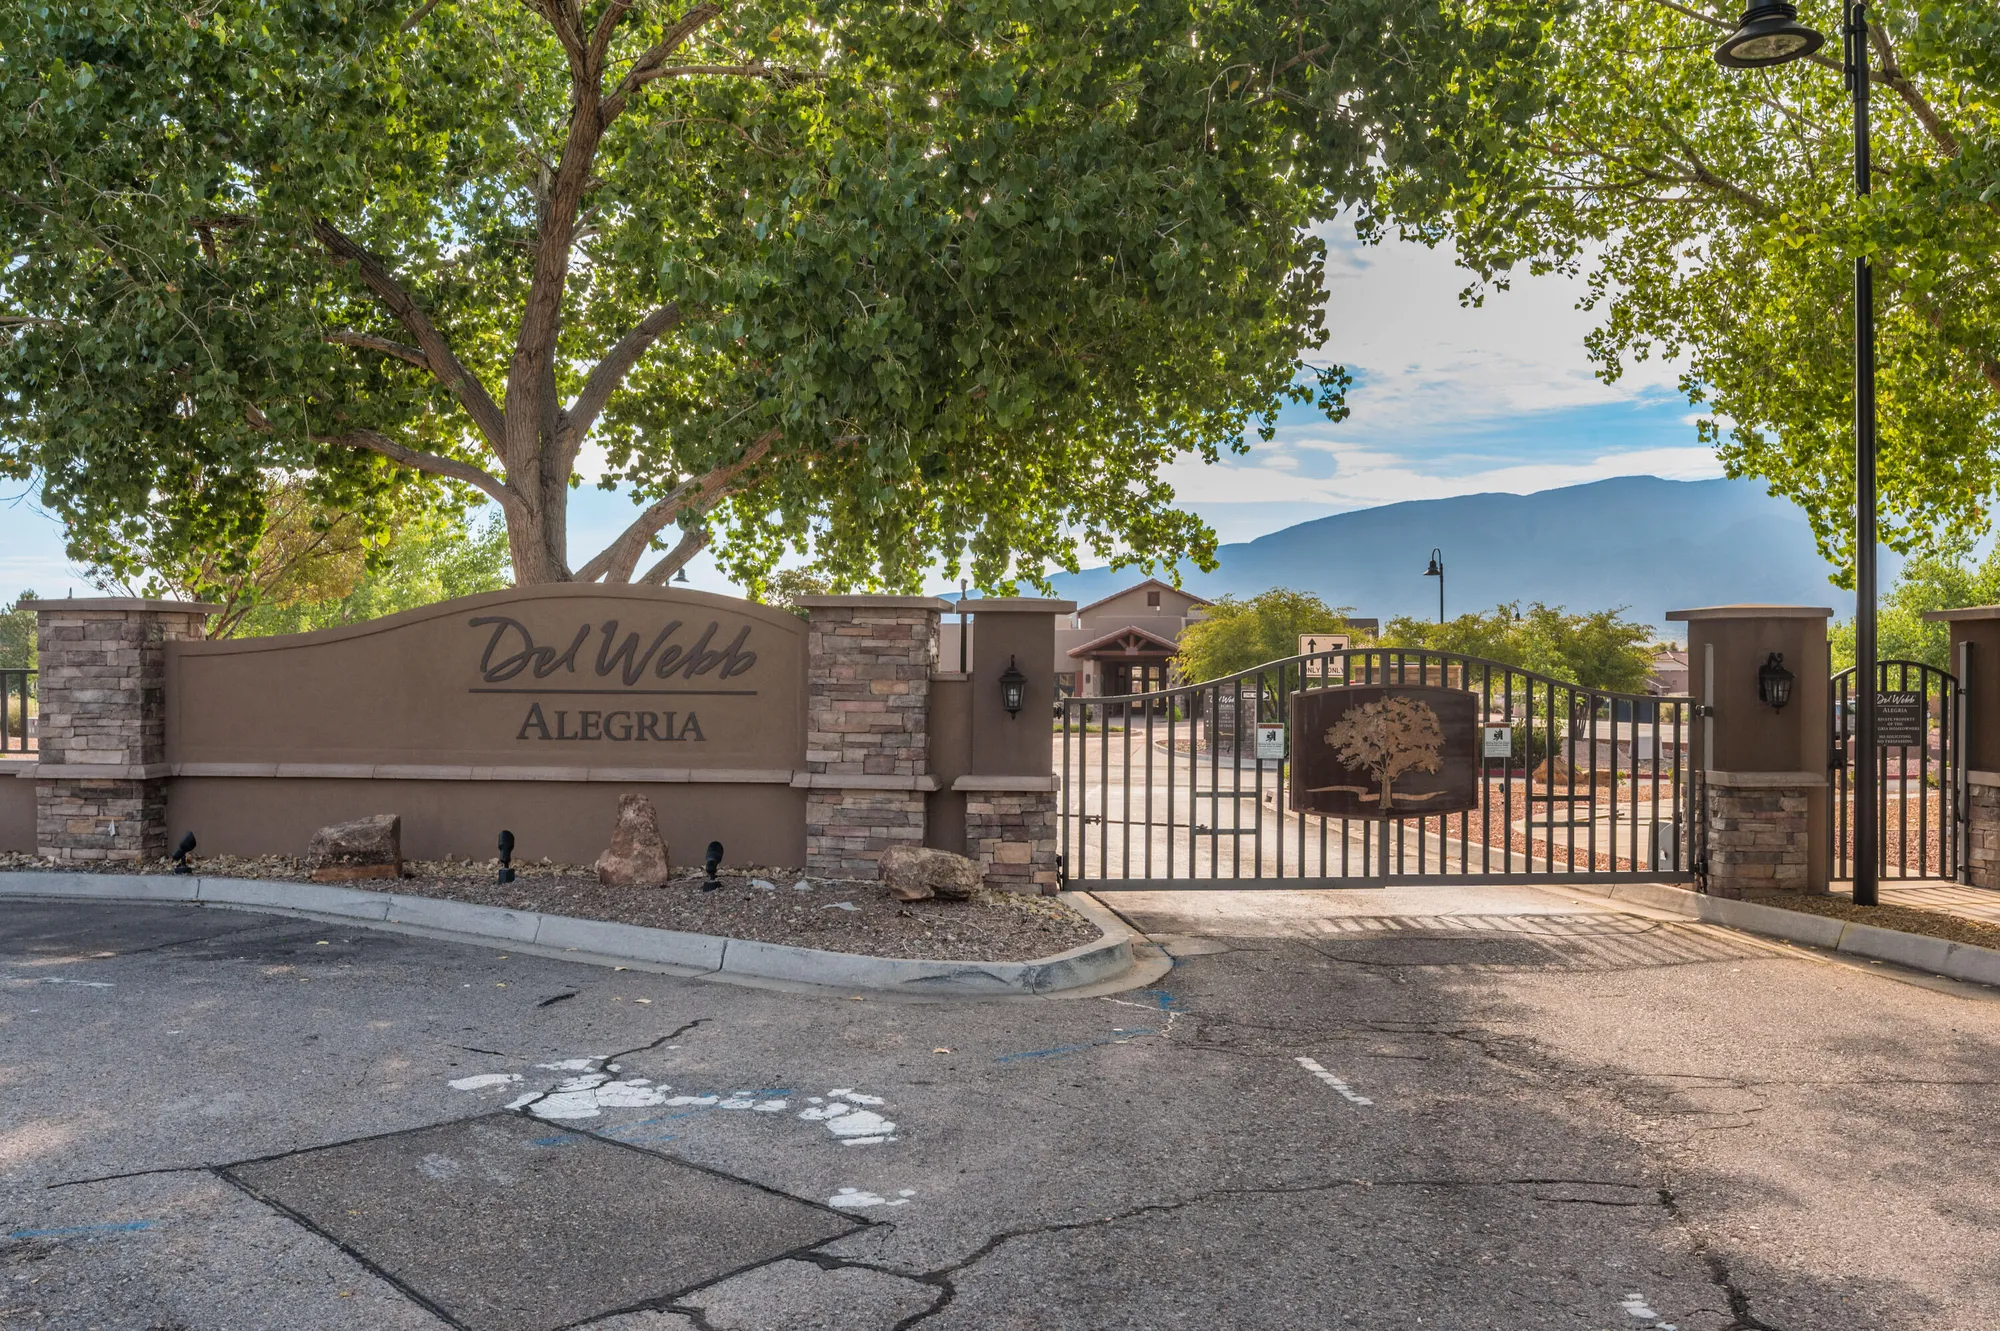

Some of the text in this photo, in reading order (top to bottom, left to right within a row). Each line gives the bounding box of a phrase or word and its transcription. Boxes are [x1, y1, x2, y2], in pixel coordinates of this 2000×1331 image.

[468, 616, 757, 686] Del Webb
[1877, 694, 1915, 704] Del Webb
[516, 702, 706, 742] ALEGRIA
